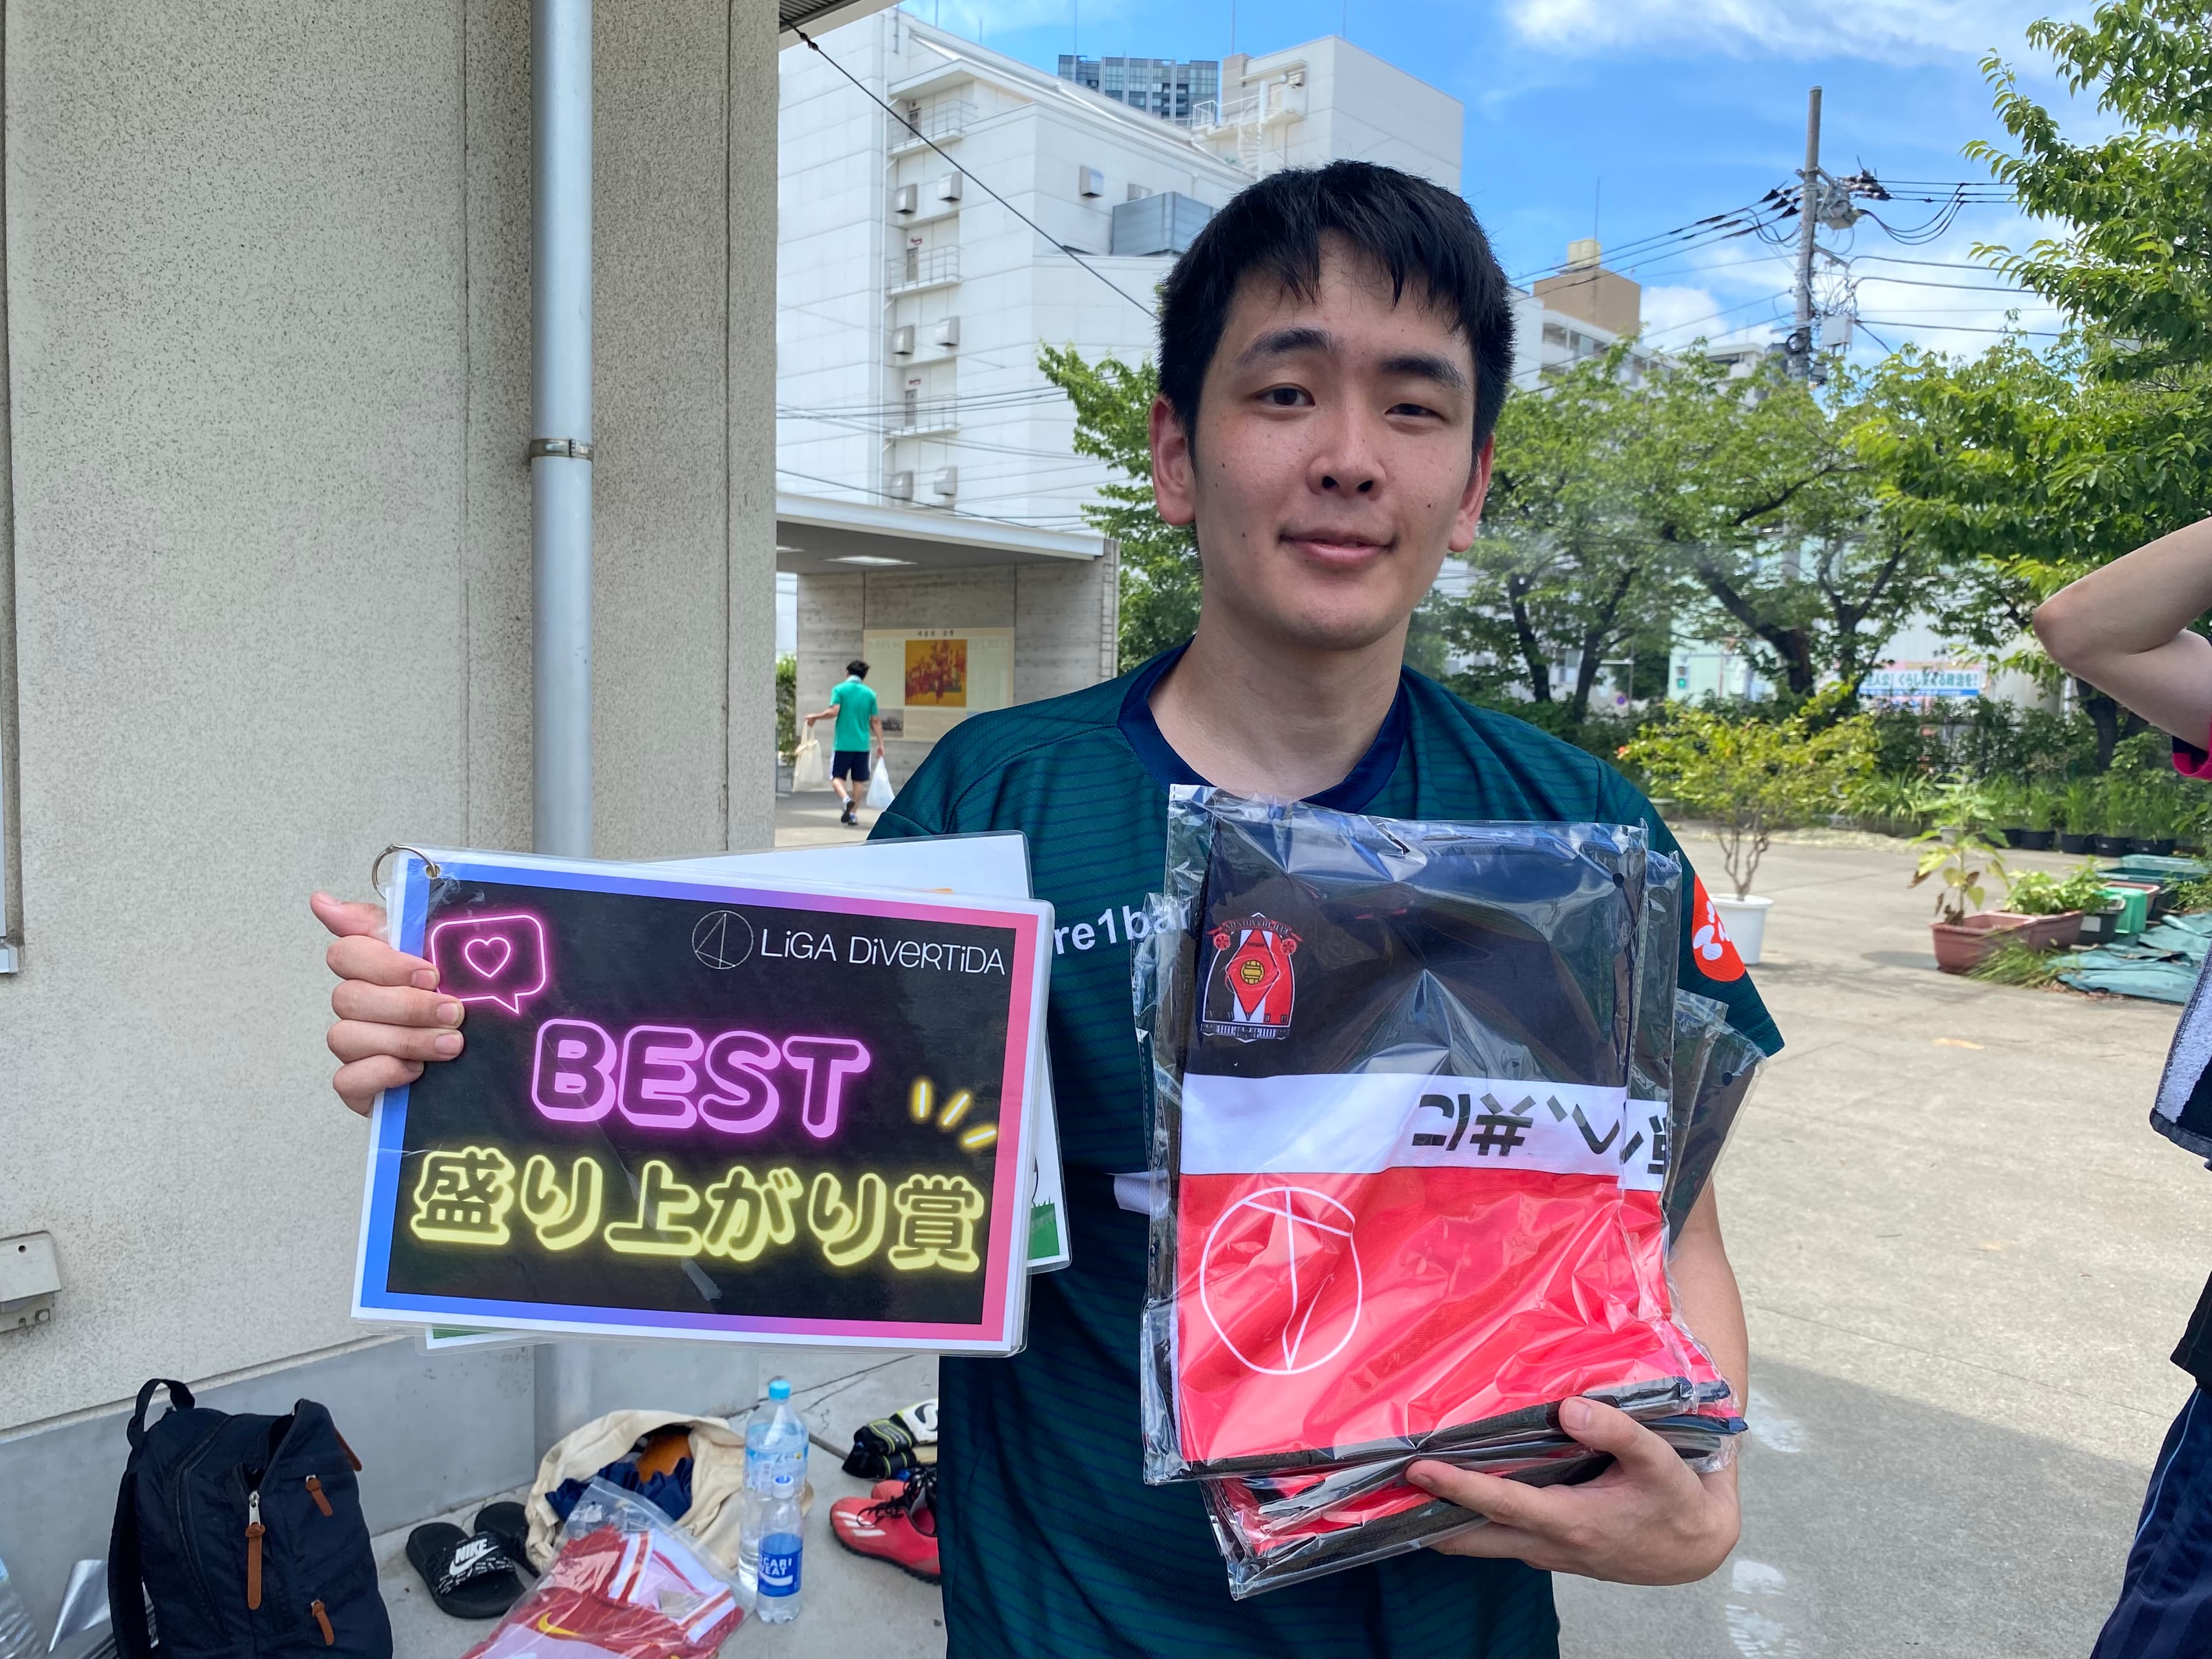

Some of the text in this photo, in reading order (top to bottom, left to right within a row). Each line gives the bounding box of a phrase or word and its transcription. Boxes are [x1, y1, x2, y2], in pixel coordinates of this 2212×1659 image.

[530, 1017, 871, 1138] BEST
[410, 1145, 984, 1272] 盛り上がり賞
[454, 1538, 488, 1565] NIKE
